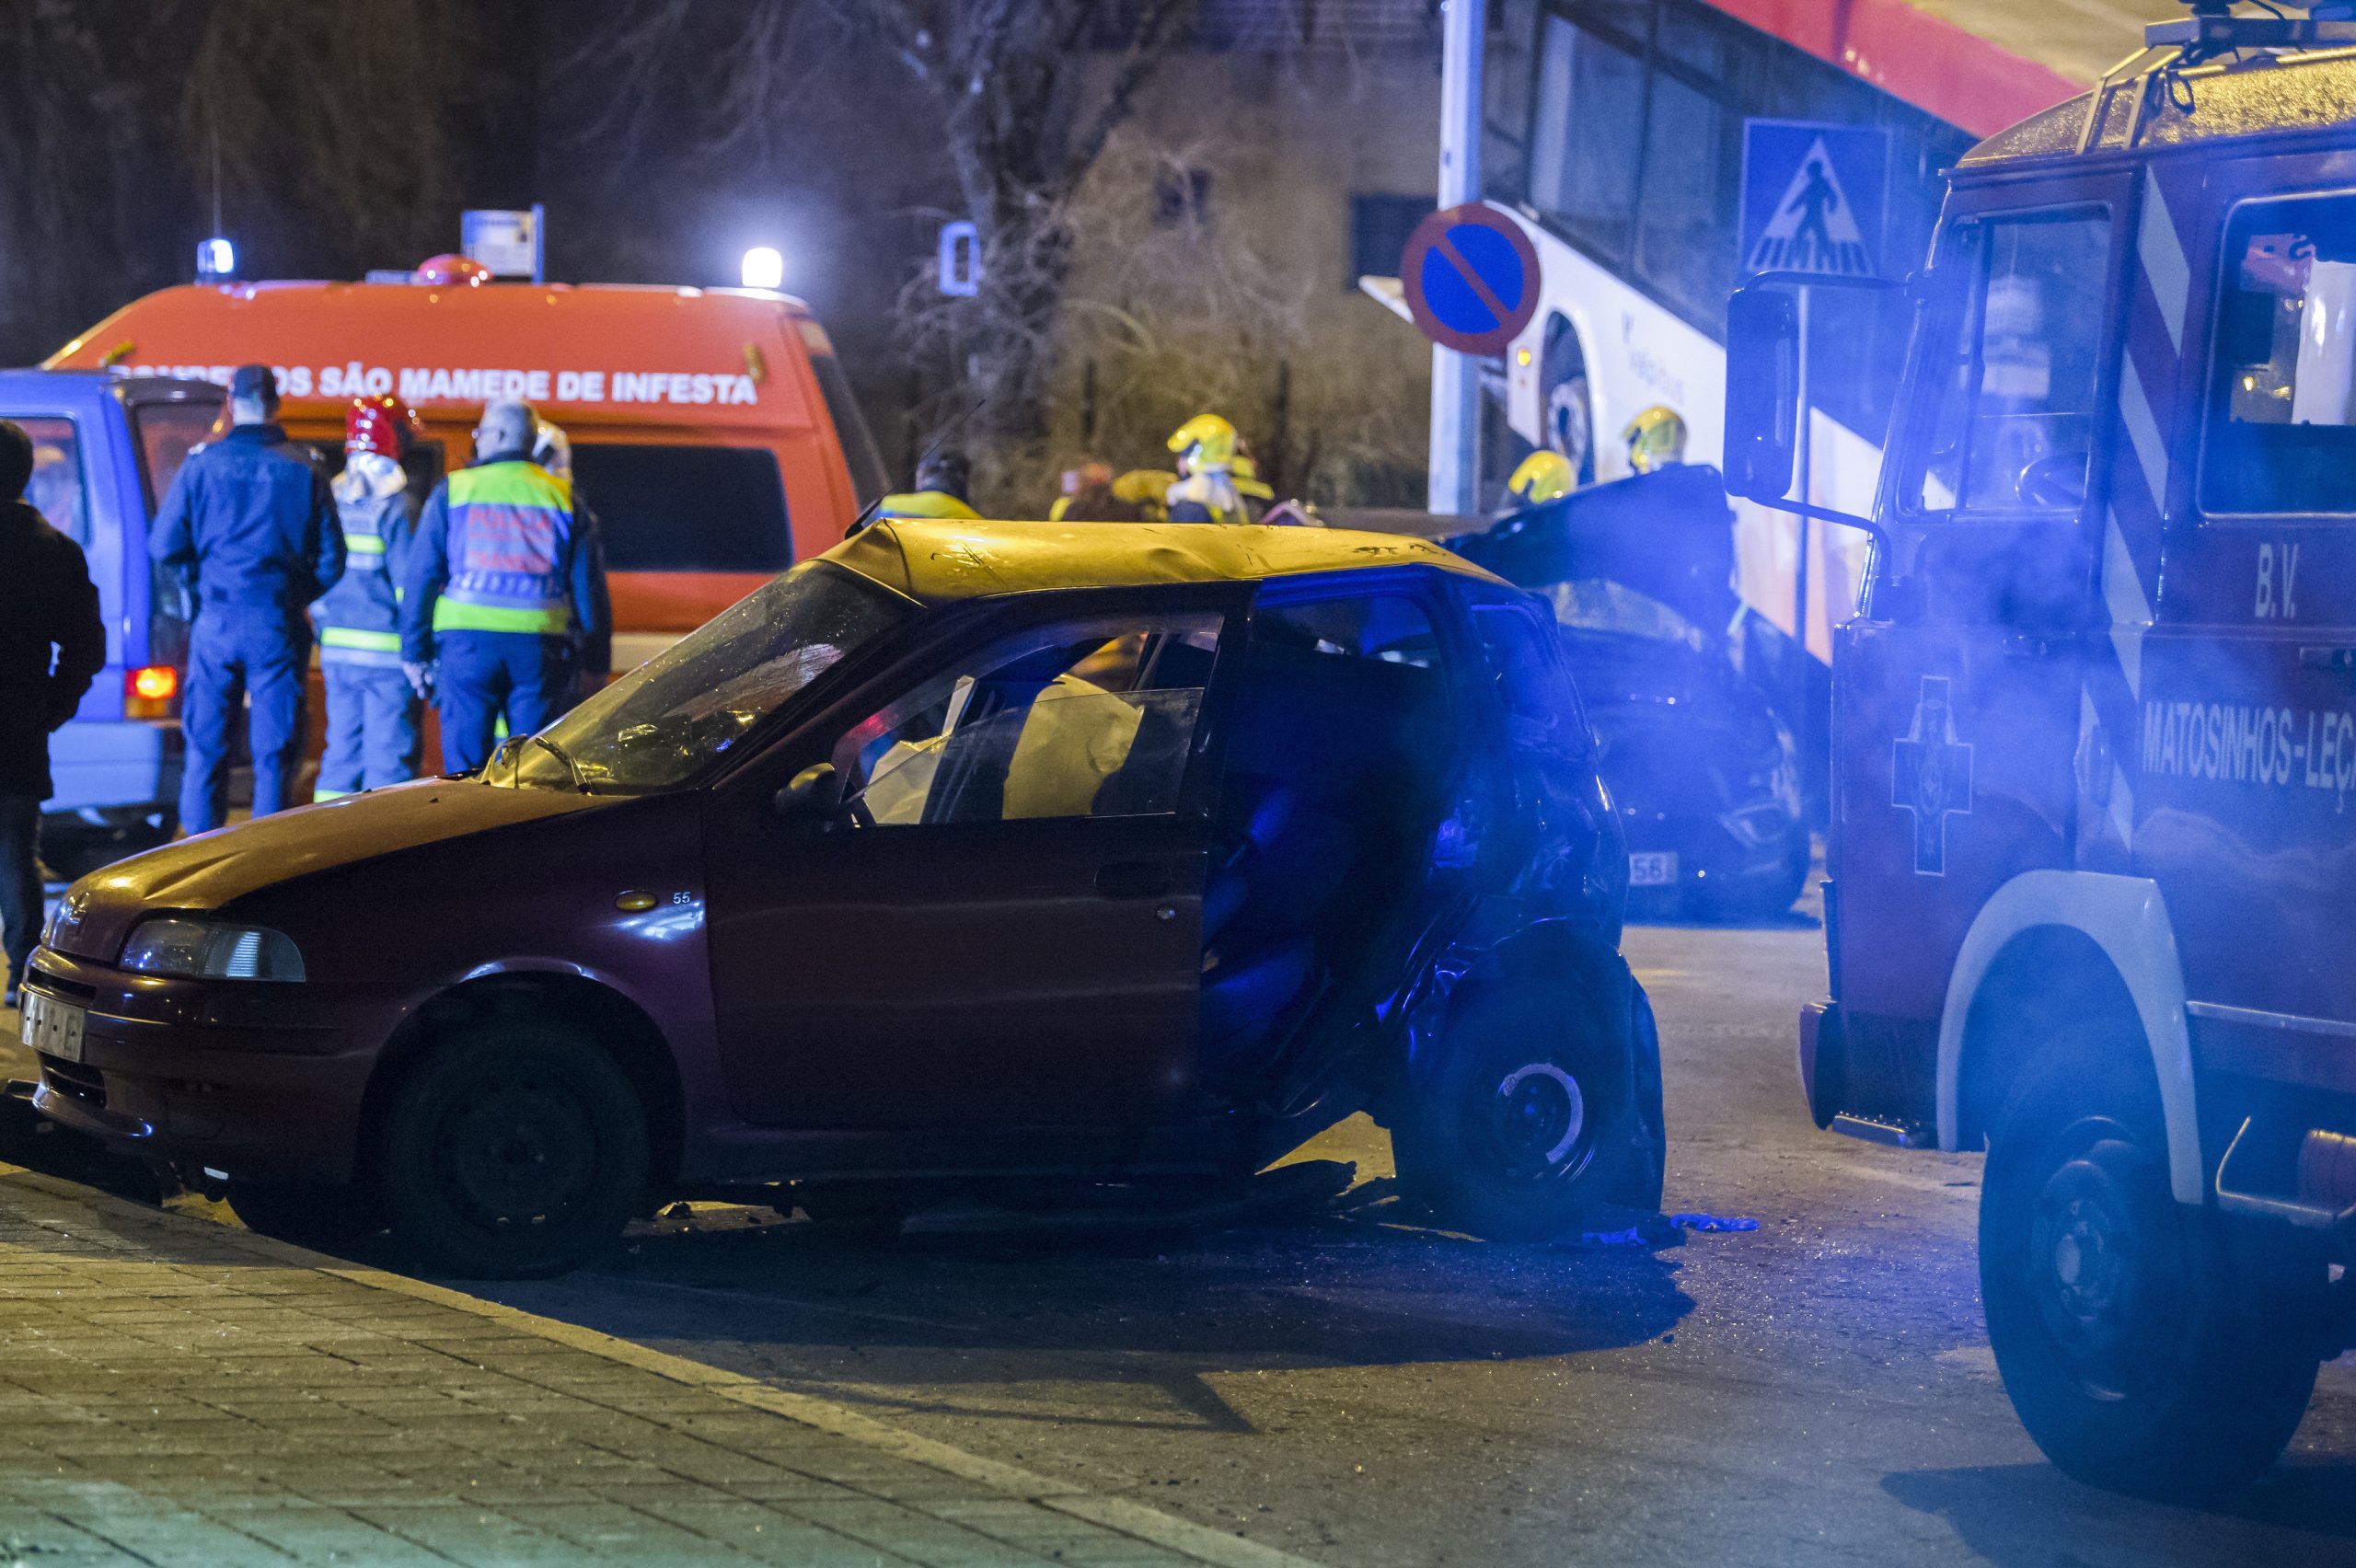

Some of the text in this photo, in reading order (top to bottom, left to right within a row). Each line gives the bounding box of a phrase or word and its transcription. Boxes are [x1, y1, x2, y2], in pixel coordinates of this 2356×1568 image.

[319, 362, 393, 398] SÃO
[398, 368, 550, 399] MAMEDE
[557, 371, 605, 401] DE
[612, 373, 757, 405] INFESTA
[2142, 701, 2356, 813] MATOSINHOS-LEÇ
[673, 892, 690, 904] 55
